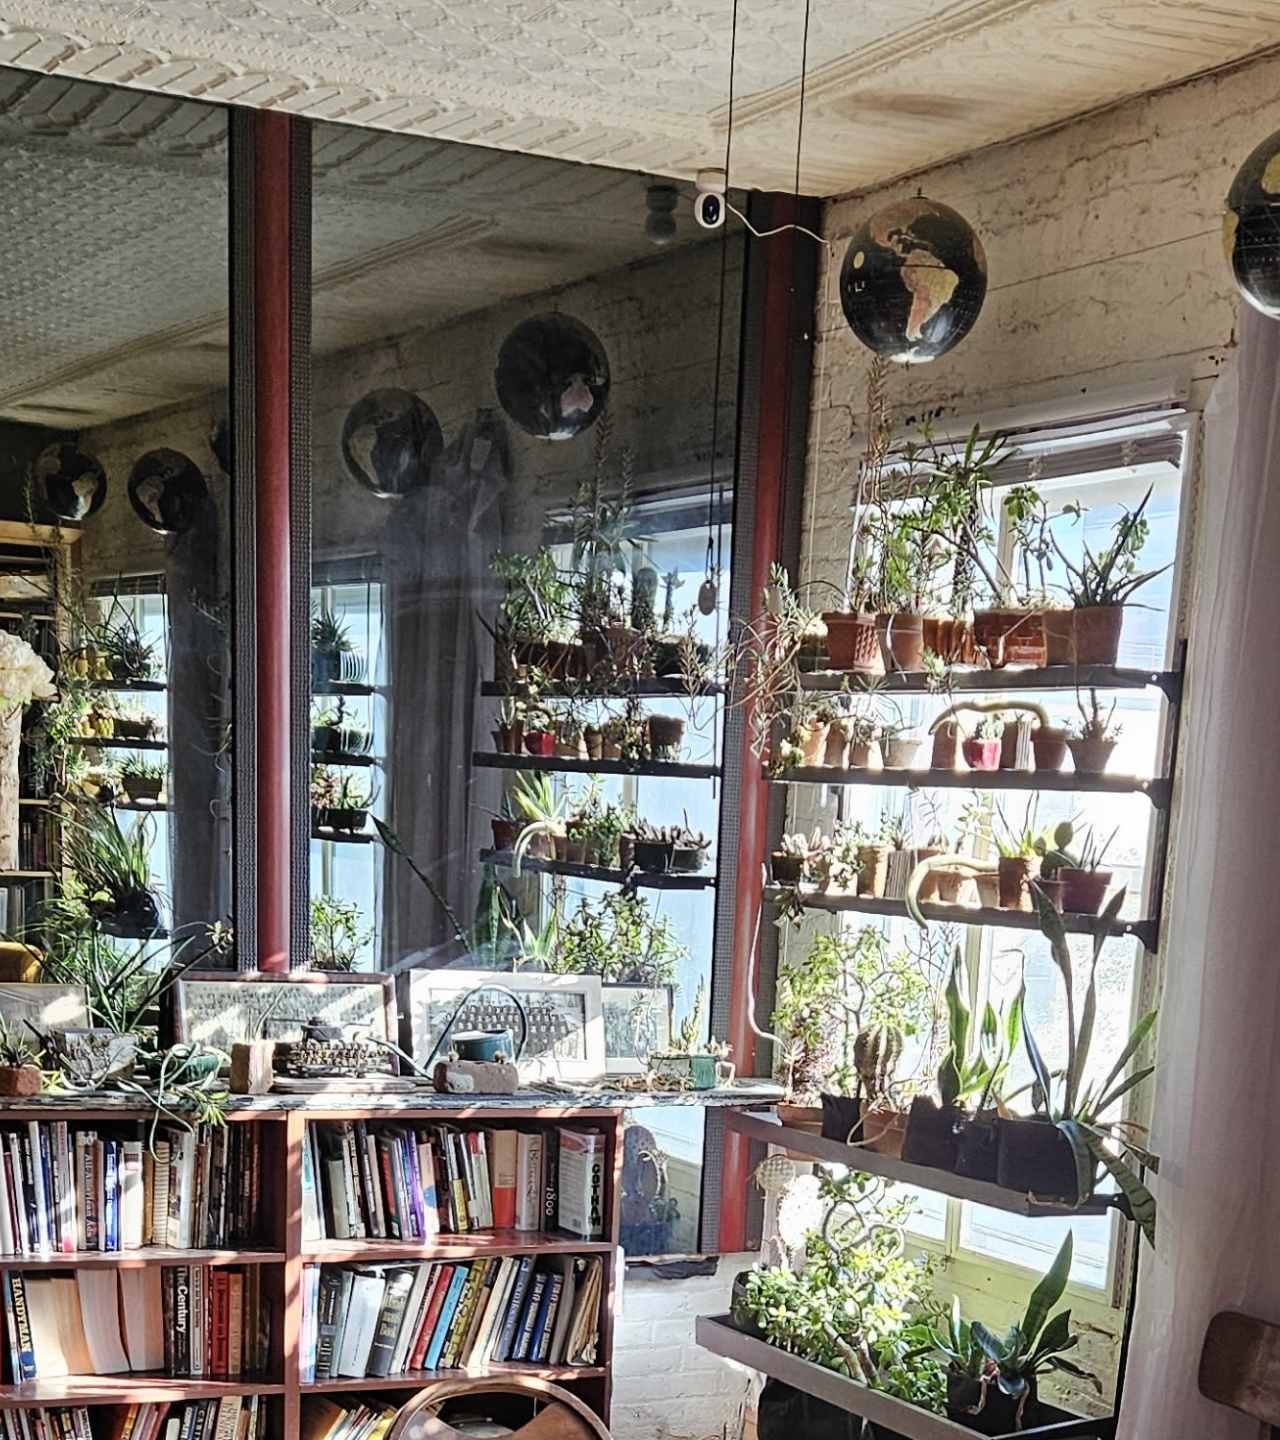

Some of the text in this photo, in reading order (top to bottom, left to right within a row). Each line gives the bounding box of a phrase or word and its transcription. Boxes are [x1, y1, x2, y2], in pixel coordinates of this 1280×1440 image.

[544, 1186, 558, 1217] 1800
[590, 1163, 601, 1227] GOTHAM
[12, 1277, 32, 1353] HANDYMAN
[176, 1286, 189, 1333] Century
